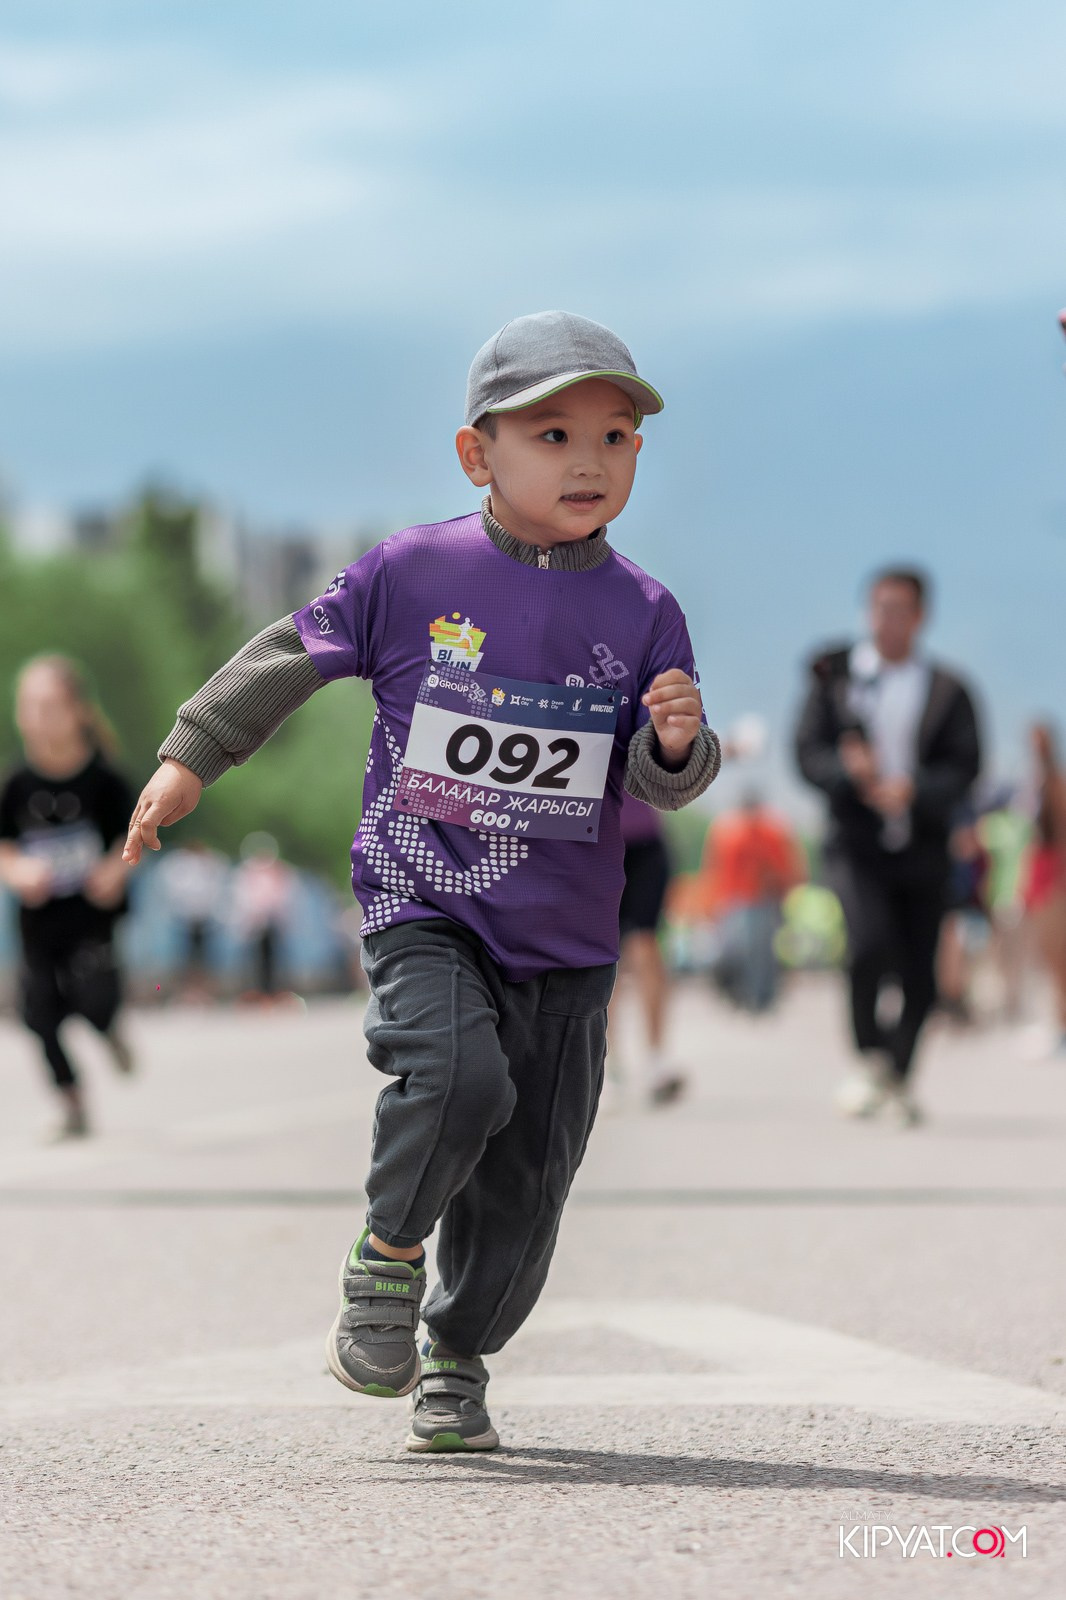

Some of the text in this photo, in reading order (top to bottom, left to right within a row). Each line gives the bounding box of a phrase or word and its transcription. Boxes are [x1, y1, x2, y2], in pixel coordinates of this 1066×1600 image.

[313, 605, 334, 634] City
[437, 649, 453, 660] BI
[439, 680, 469, 693] GROUP
[590, 704, 614, 713] INVICTUS
[445, 723, 581, 790] 092
[407, 773, 594, 817] БАЛАЛАР ЖАРЫСЫ
[470, 809, 511, 829] 600
[375, 1281, 410, 1293] BIKER
[424, 1361, 457, 1370] BIKER
